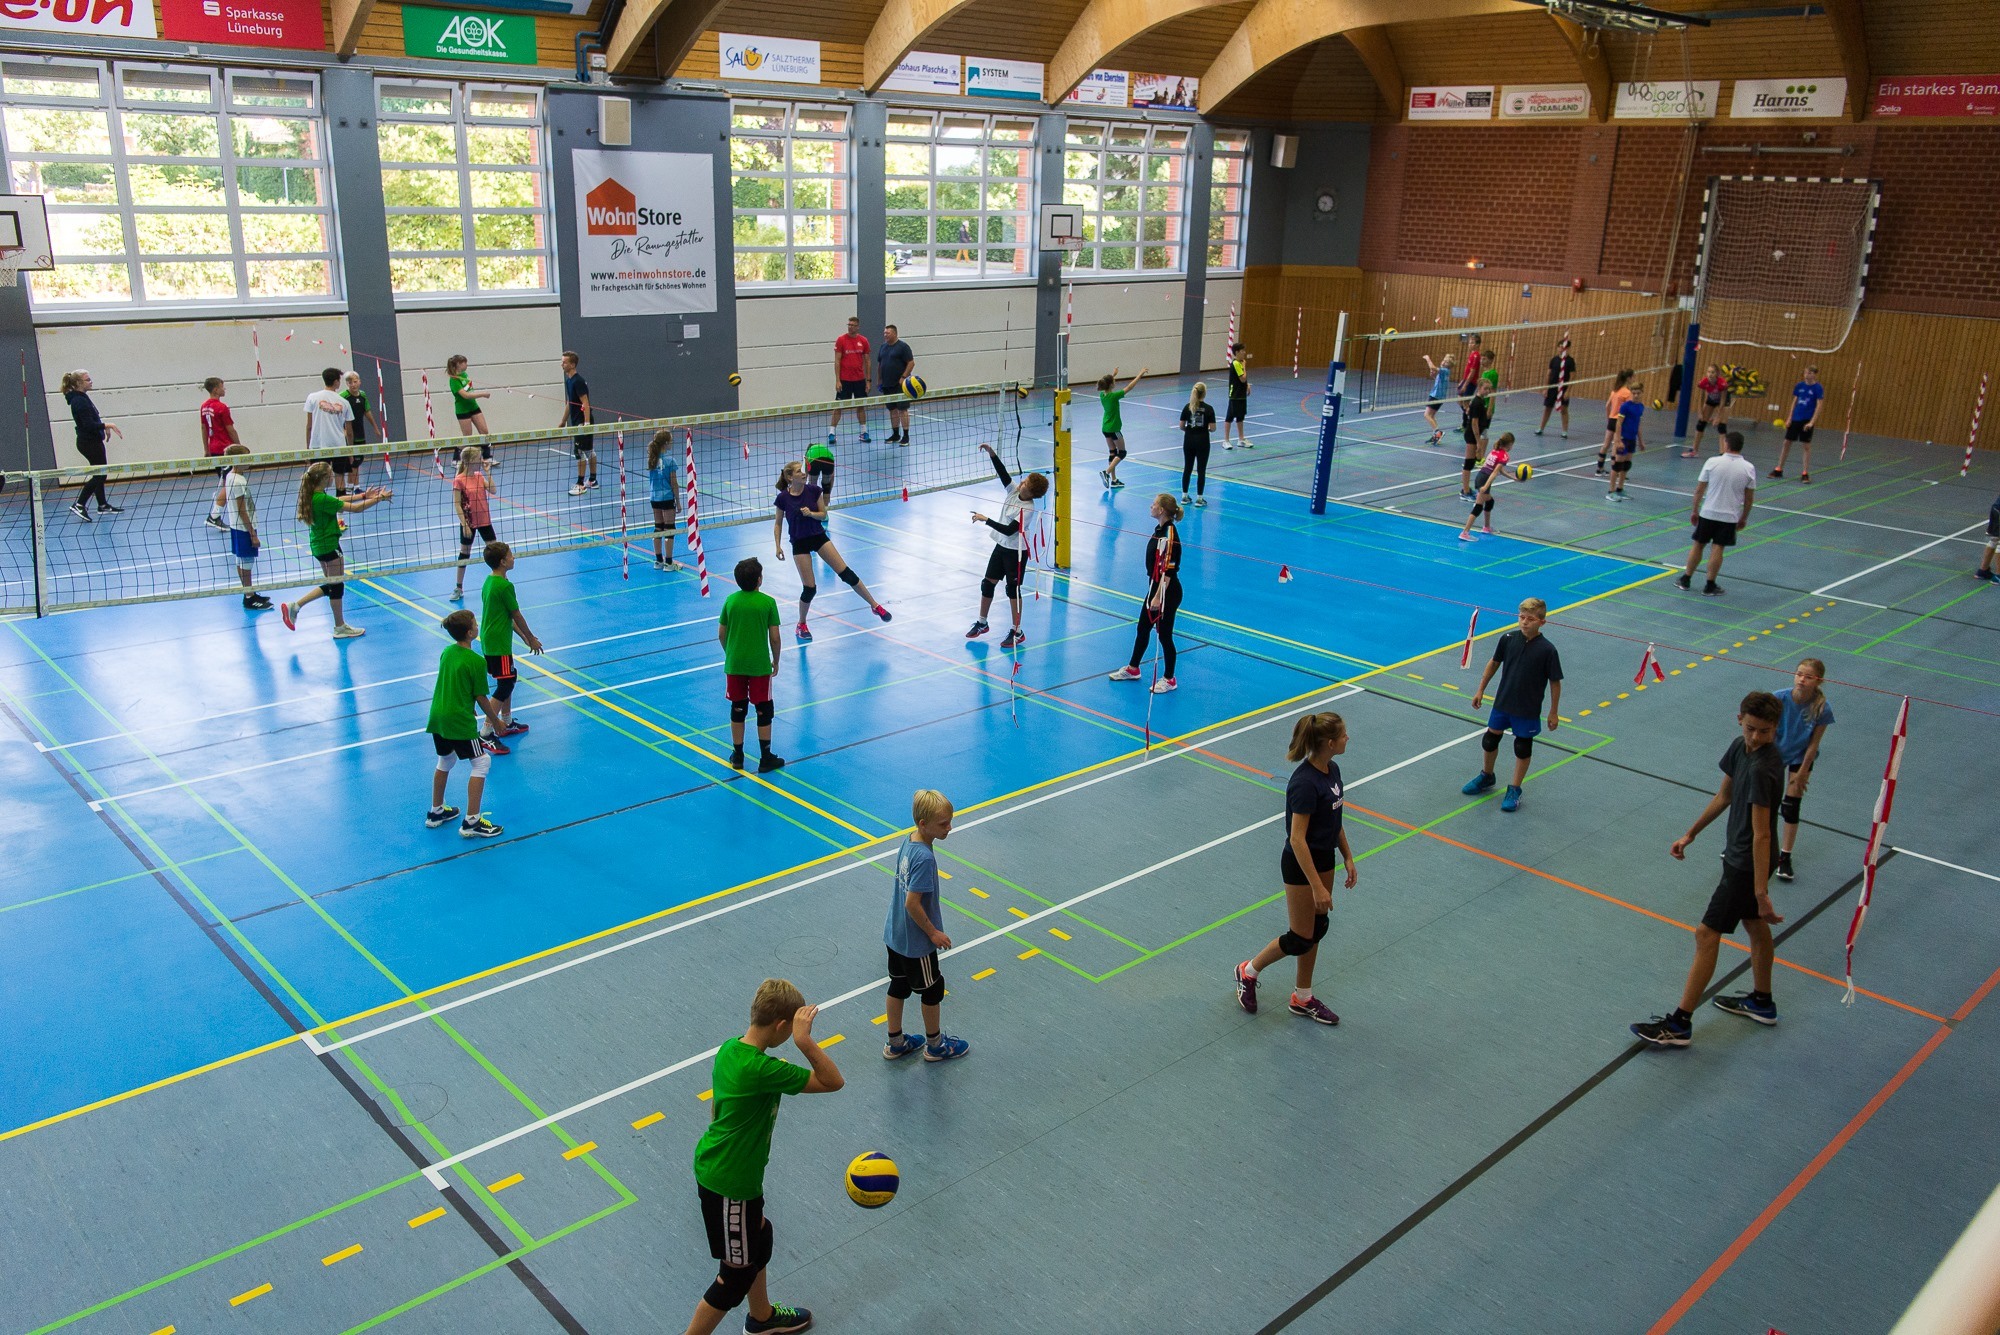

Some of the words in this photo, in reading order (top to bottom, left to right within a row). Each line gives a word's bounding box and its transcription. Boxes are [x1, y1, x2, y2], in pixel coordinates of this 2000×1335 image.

[225, 6, 285, 21] Sparkasse
[227, 21, 283, 39] Lüneburg
[437, 15, 507, 49] AOK
[436, 45, 447, 53] Die
[448, 46, 509, 58] Gesundheitskasse.
[771, 54, 815, 65] SALZTHERME
[921, 64, 949, 74] Plaschka
[982, 67, 1009, 78] SYSTEM
[1879, 83, 1900, 96] Ein
[1903, 82, 1956, 96] starkes
[1960, 82, 2000, 95] Team.
[1753, 93, 1809, 107] Harms
[611, 238, 633, 260] Die
[590, 268, 707, 280] www.meinwohnstore.de
[590, 284, 601, 292] Ihr
[601, 283, 644, 293] Fachgeschäft
[644, 283, 654, 291] für
[655, 282, 681, 290] Schönes
[682, 282, 707, 290] Wohnen
